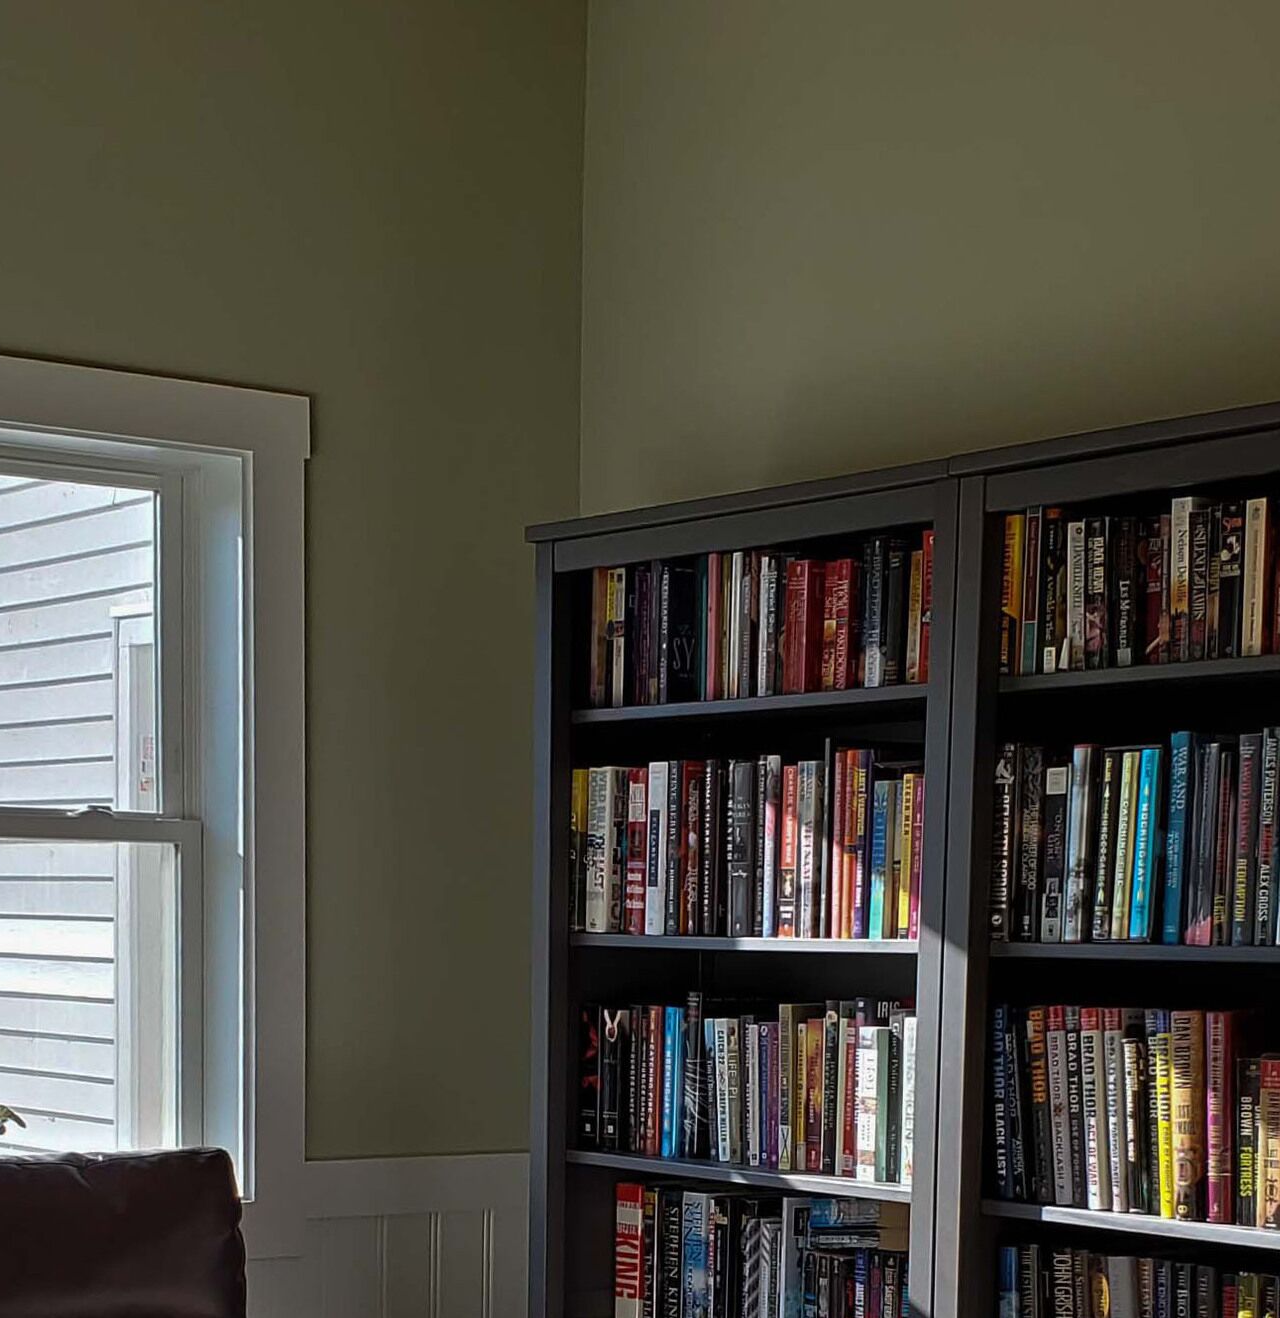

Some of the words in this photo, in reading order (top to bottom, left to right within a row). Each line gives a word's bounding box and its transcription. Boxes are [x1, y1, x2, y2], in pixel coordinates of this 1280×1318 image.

[1177, 530, 1188, 562] Nelson
[1177, 567, 1186, 604] DeMille
[1178, 747, 1187, 777] WAR
[1176, 782, 1186, 809] AND
[1235, 858, 1247, 921] REDEMPTION
[1260, 864, 1270, 886] ALEX
[1259, 890, 1270, 921] CROSS
[993, 1008, 1007, 1052] BRAD
[1082, 1036, 1093, 1075] BRAD
[994, 1055, 1007, 1099] THOR
[1085, 1079, 1096, 1118] THOR
[995, 1103, 1006, 1145] BLACK
[997, 1149, 1007, 1176] LIST
[1239, 1146, 1252, 1197] FORTRESS
[668, 1207, 679, 1279] STEPHEN
[692, 1202, 702, 1263] STEPHEN
[614, 1236, 638, 1299] KING
